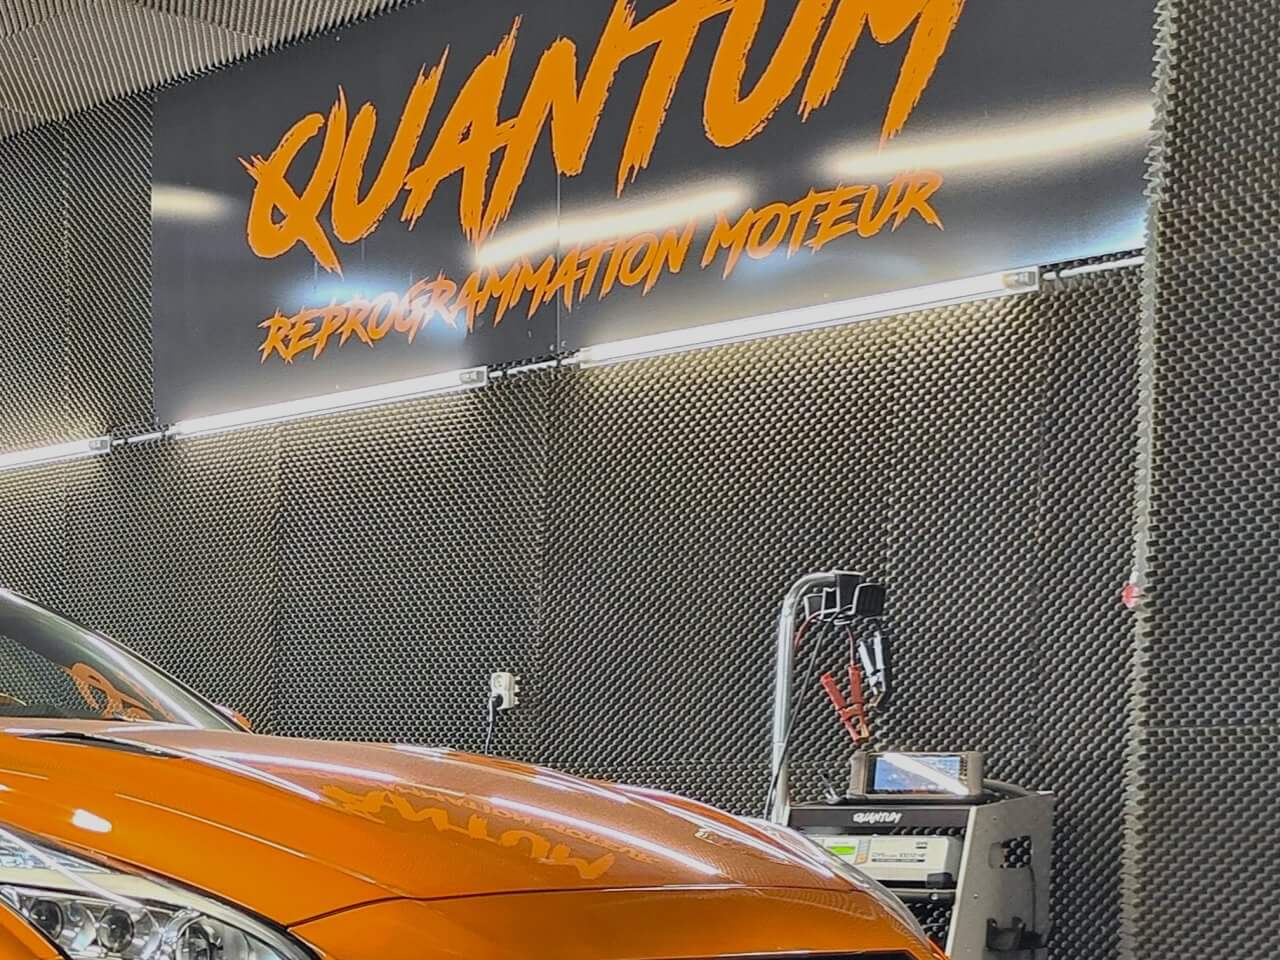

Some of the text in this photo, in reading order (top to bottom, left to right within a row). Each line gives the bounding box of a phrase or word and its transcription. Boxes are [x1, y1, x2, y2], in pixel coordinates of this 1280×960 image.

[239, 0, 966, 281] QUANTUM
[257, 169, 945, 366] REPROGRAMMATION MOTEUR
